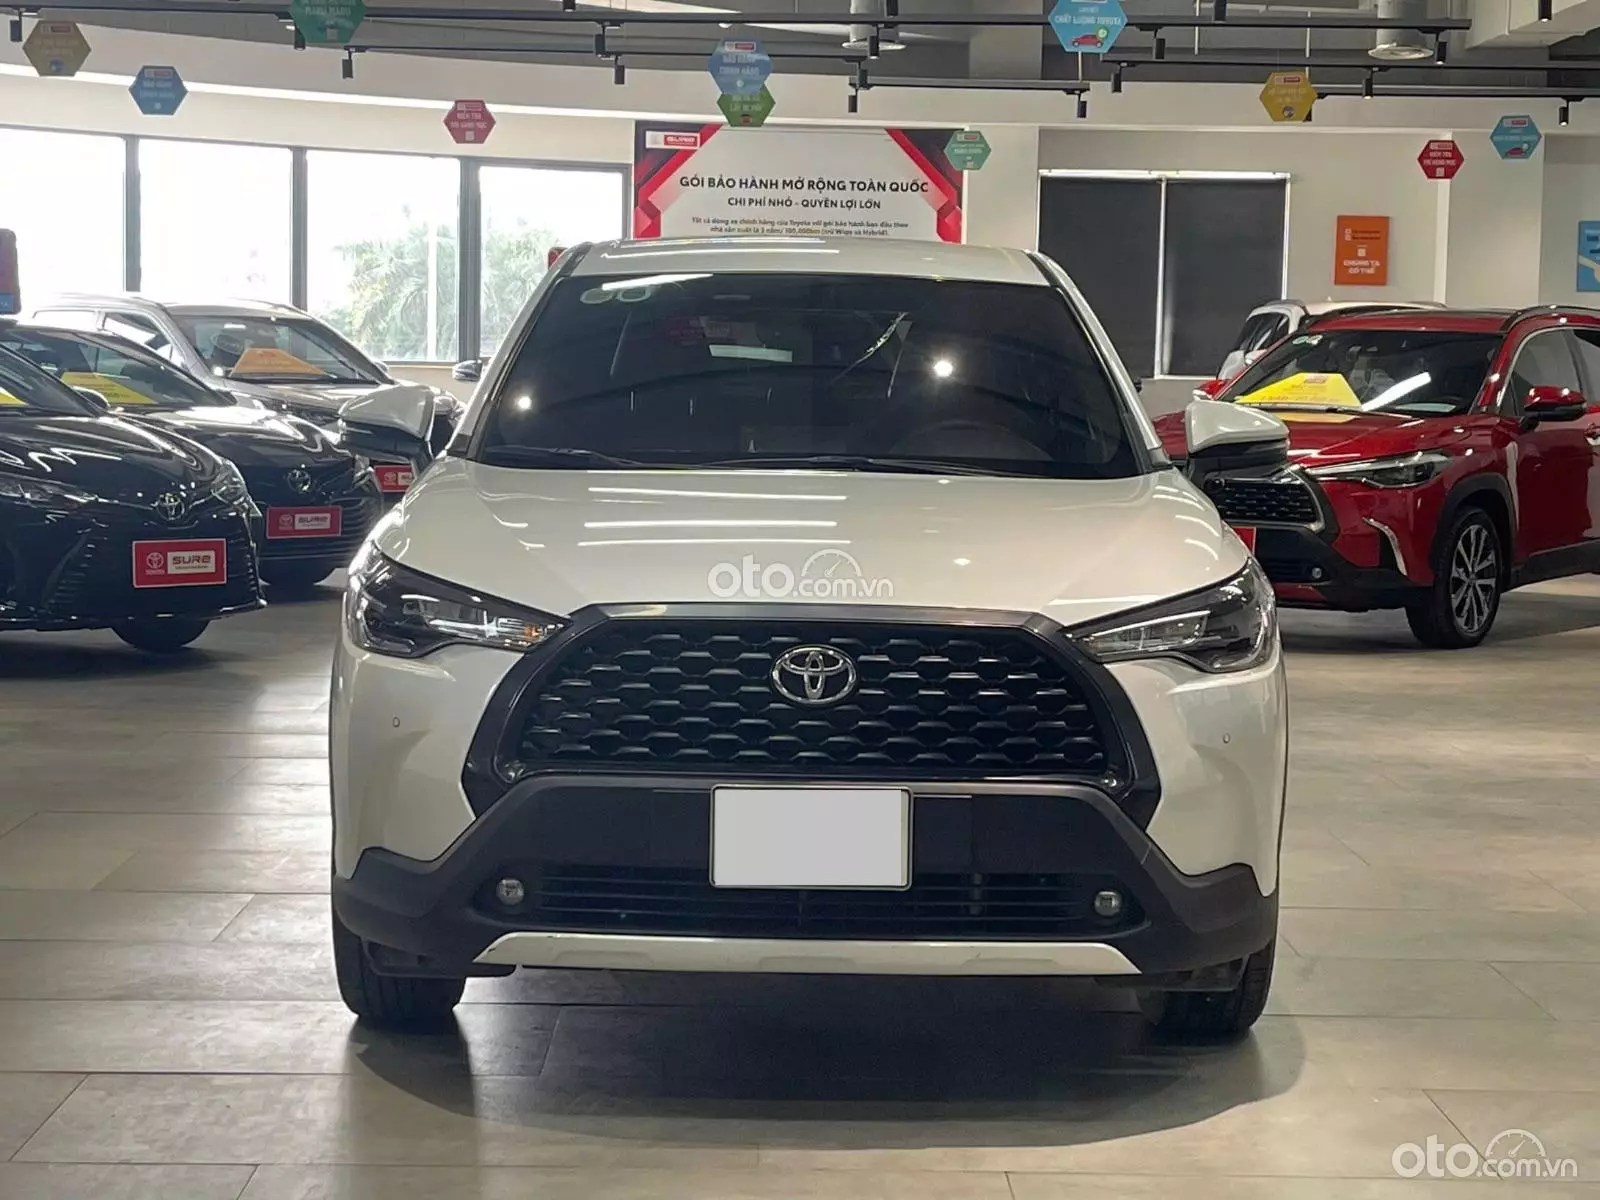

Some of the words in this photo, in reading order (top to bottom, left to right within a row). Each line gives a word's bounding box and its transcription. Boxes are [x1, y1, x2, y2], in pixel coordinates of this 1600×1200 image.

[680, 174, 704, 187] GÓI
[708, 174, 736, 188] BẢO
[740, 176, 778, 190] HÀNH
[782, 176, 804, 190] MỞ
[807, 177, 846, 193] RỘNG
[849, 178, 886, 192] TOÀN
[889, 179, 928, 192] QUỐC
[728, 197, 746, 206] CHI
[748, 196, 766, 207] PHÍ
[768, 196, 793, 207] NHỎ
[801, 198, 837, 208] QUYỀN
[840, 199, 857, 210] LỢI
[859, 199, 881, 209] LỚN
[172, 554, 211, 565] SURE
